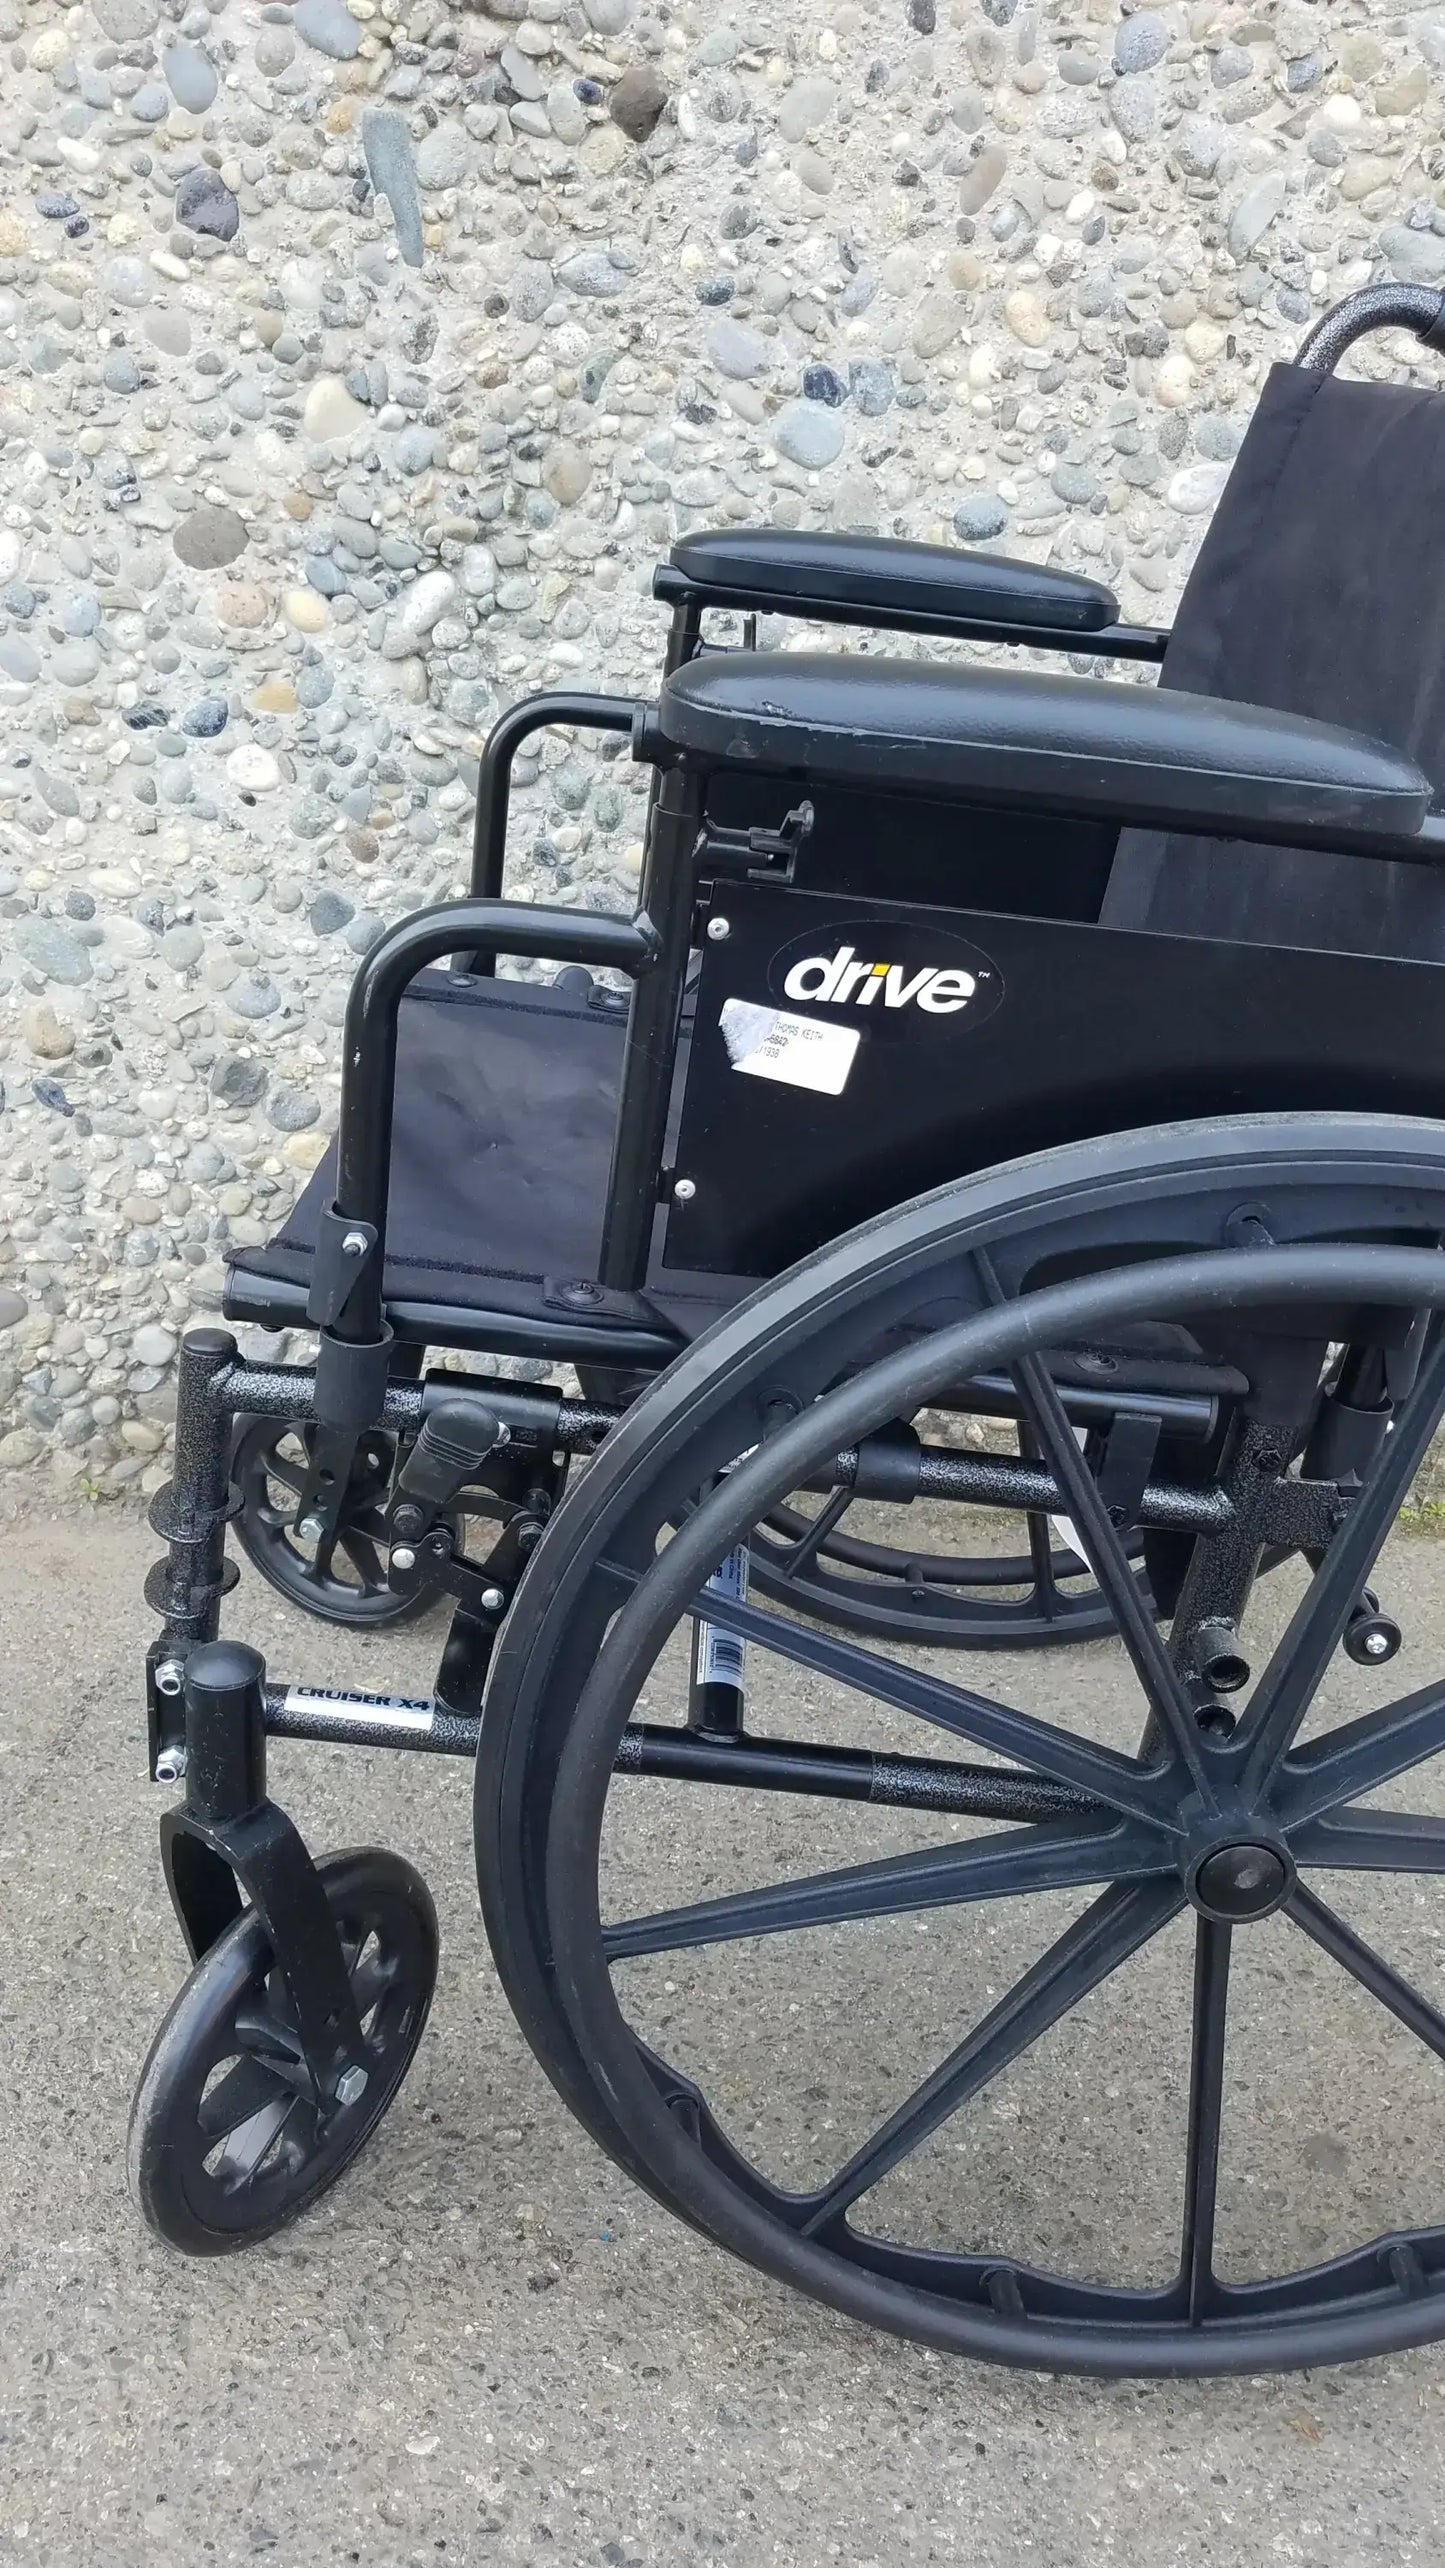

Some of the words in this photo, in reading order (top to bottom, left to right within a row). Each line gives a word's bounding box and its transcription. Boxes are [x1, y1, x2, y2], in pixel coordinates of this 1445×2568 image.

[784, 946, 976, 1014] drive
[775, 1022, 799, 1036] THOMAS
[801, 1029, 824, 1040] KEITH
[297, 1687, 391, 1706] CRUISER
[398, 1698, 430, 1711] X4
